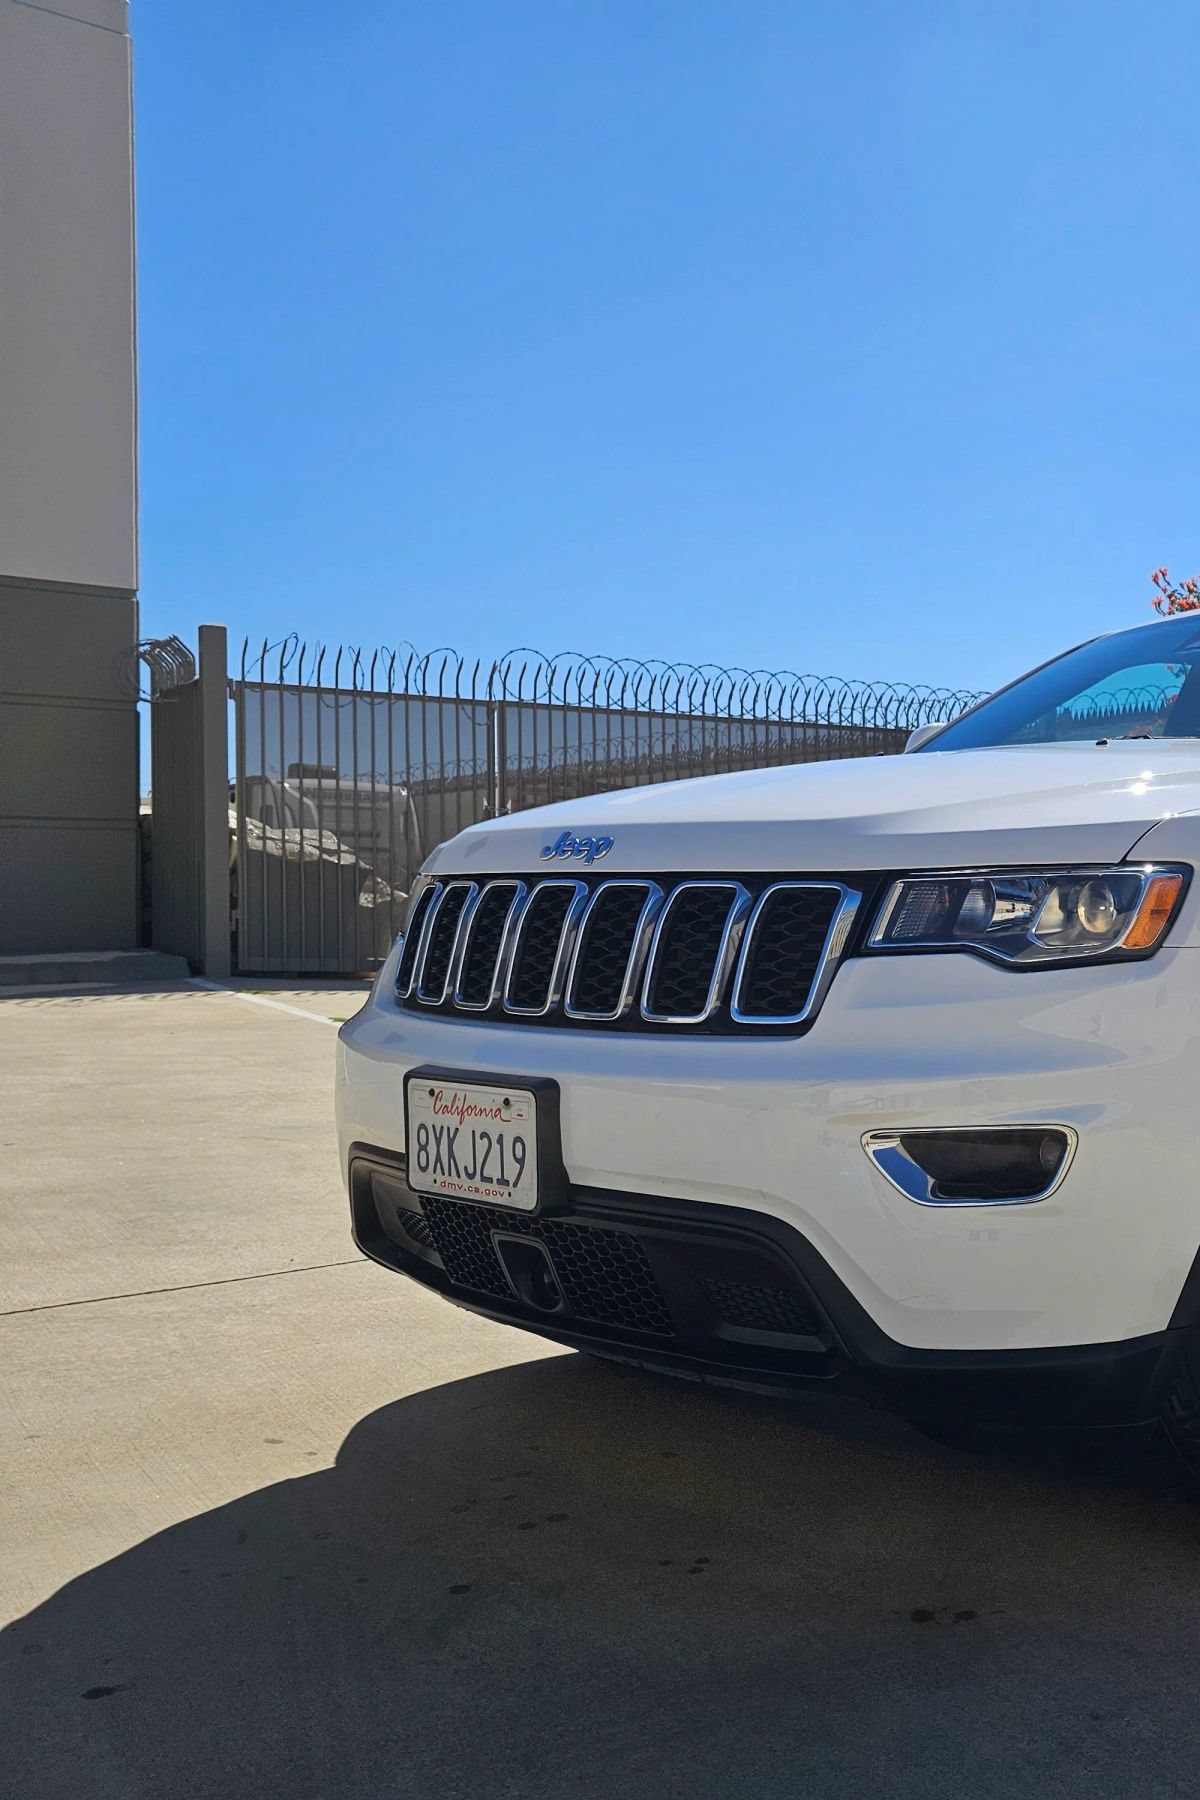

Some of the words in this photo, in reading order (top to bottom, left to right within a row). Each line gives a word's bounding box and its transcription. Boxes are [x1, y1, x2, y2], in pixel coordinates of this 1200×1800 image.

[540, 830, 615, 866] Jeep
[432, 1090, 511, 1125] California
[416, 1123, 526, 1189] 8XKJ219
[440, 1179, 505, 1197] dmv.ca.gov
